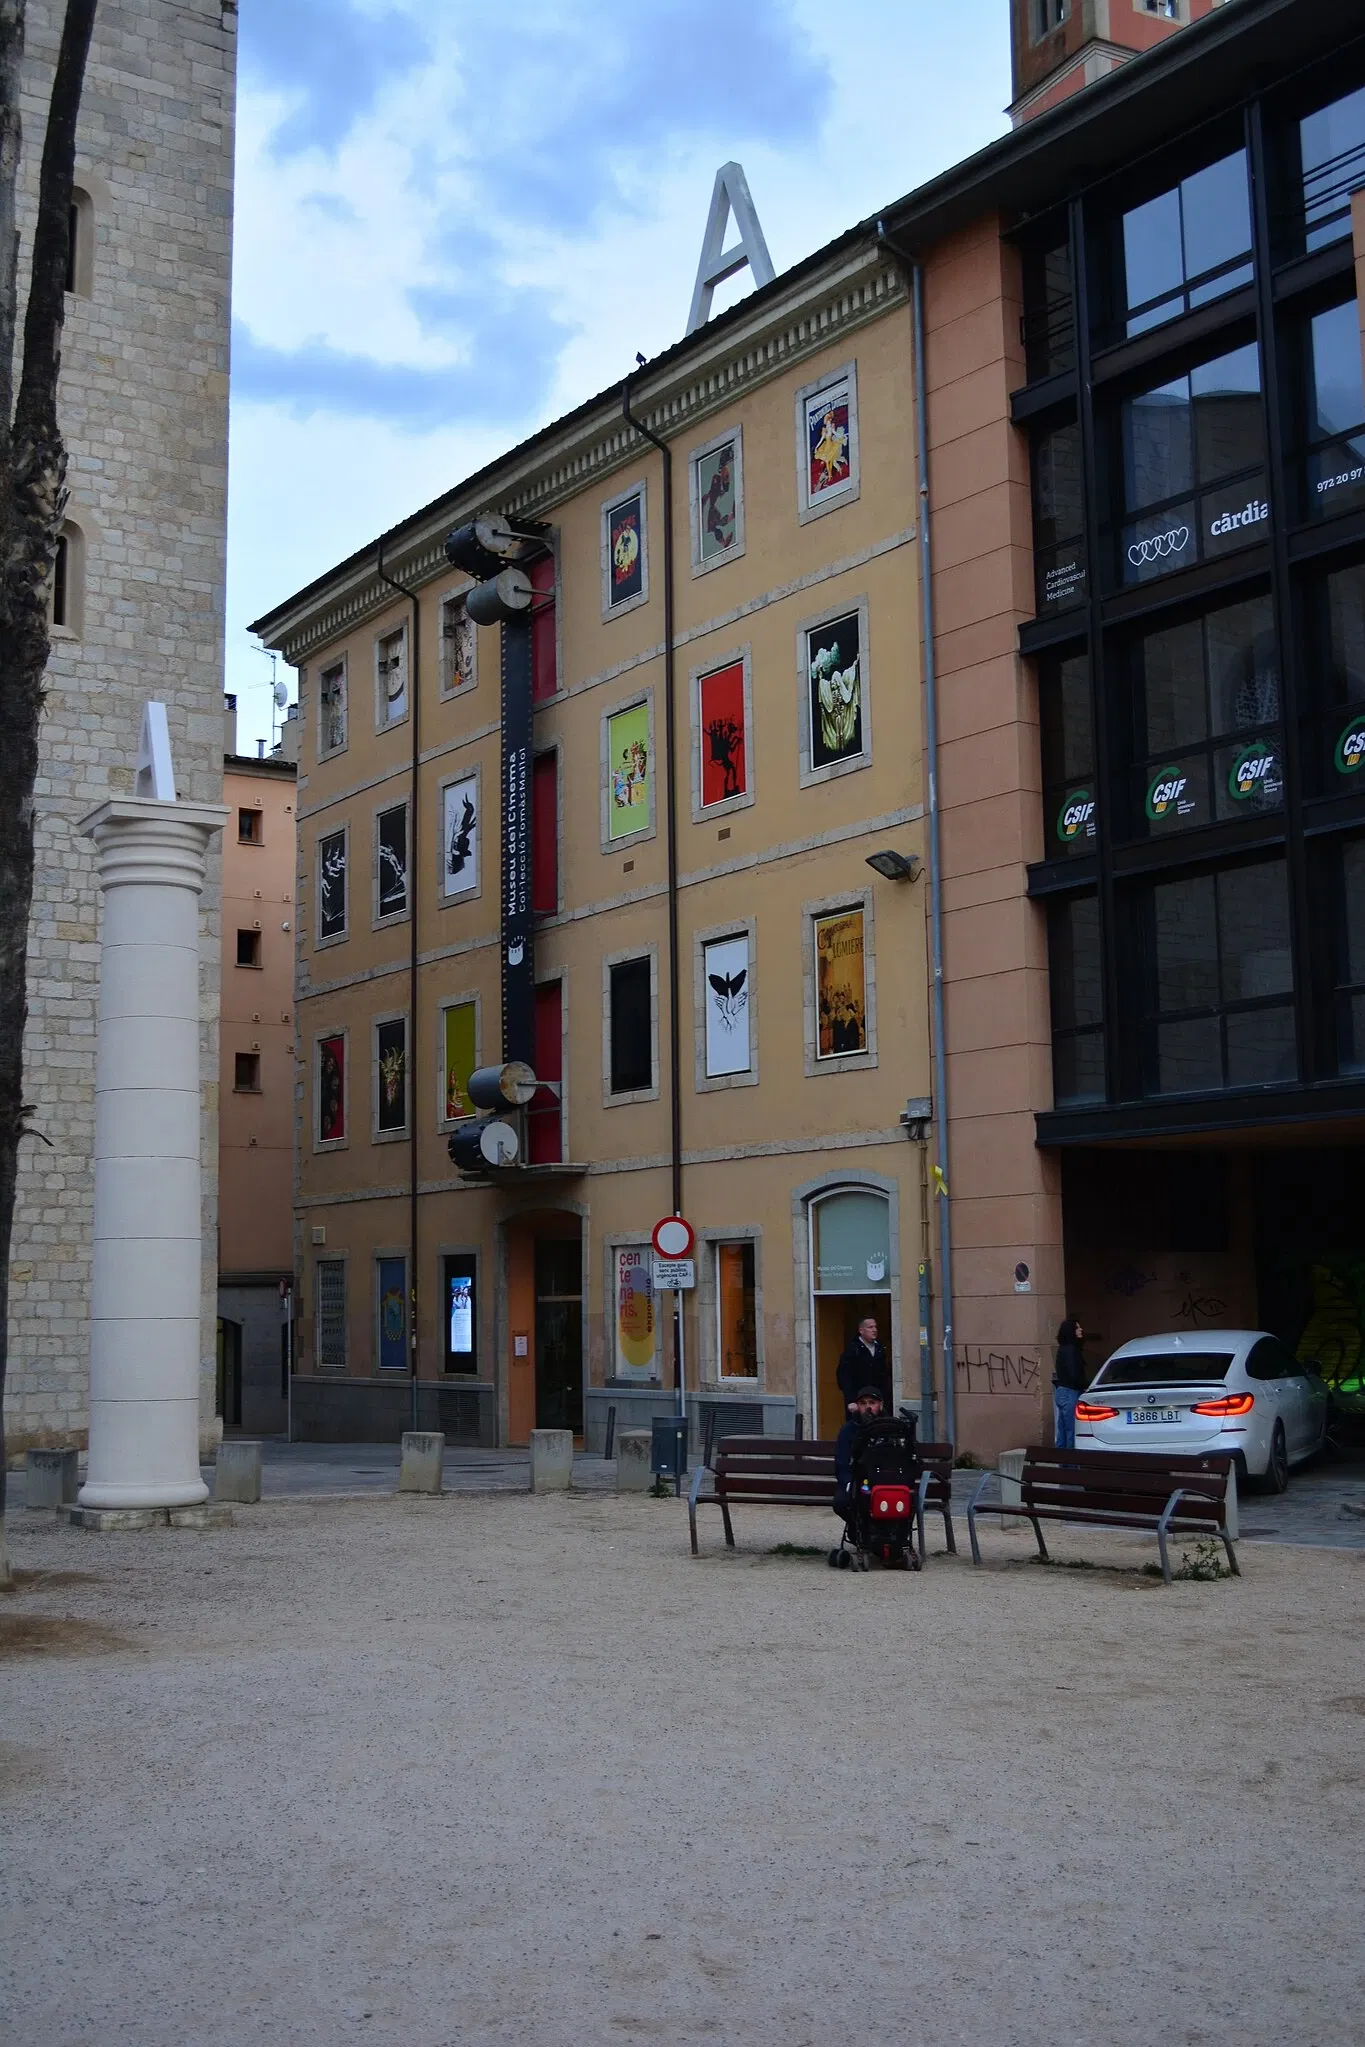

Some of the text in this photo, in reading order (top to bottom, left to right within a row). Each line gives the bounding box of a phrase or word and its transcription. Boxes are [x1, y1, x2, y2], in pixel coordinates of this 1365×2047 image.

[1317, 482, 1335, 492] 972
[1336, 473, 1349, 485] 20
[1350, 467, 1362, 480] 97
[1046, 562, 1076, 580] Advanced
[1046, 587, 1075, 602] Medicine
[518, 747, 526, 792] Mallol
[1237, 756, 1274, 782] CSIF
[1152, 778, 1187, 804] CSIF
[518, 793, 526, 839] Tomàs
[1063, 802, 1095, 826] CSIF
[508, 751, 517, 916] Museu del Cinema
[620, 1251, 641, 1266] cen
[620, 1268, 631, 1284] te
[620, 1286, 634, 1300] na
[1133, 1410, 1180, 1422] 3866 LBT
